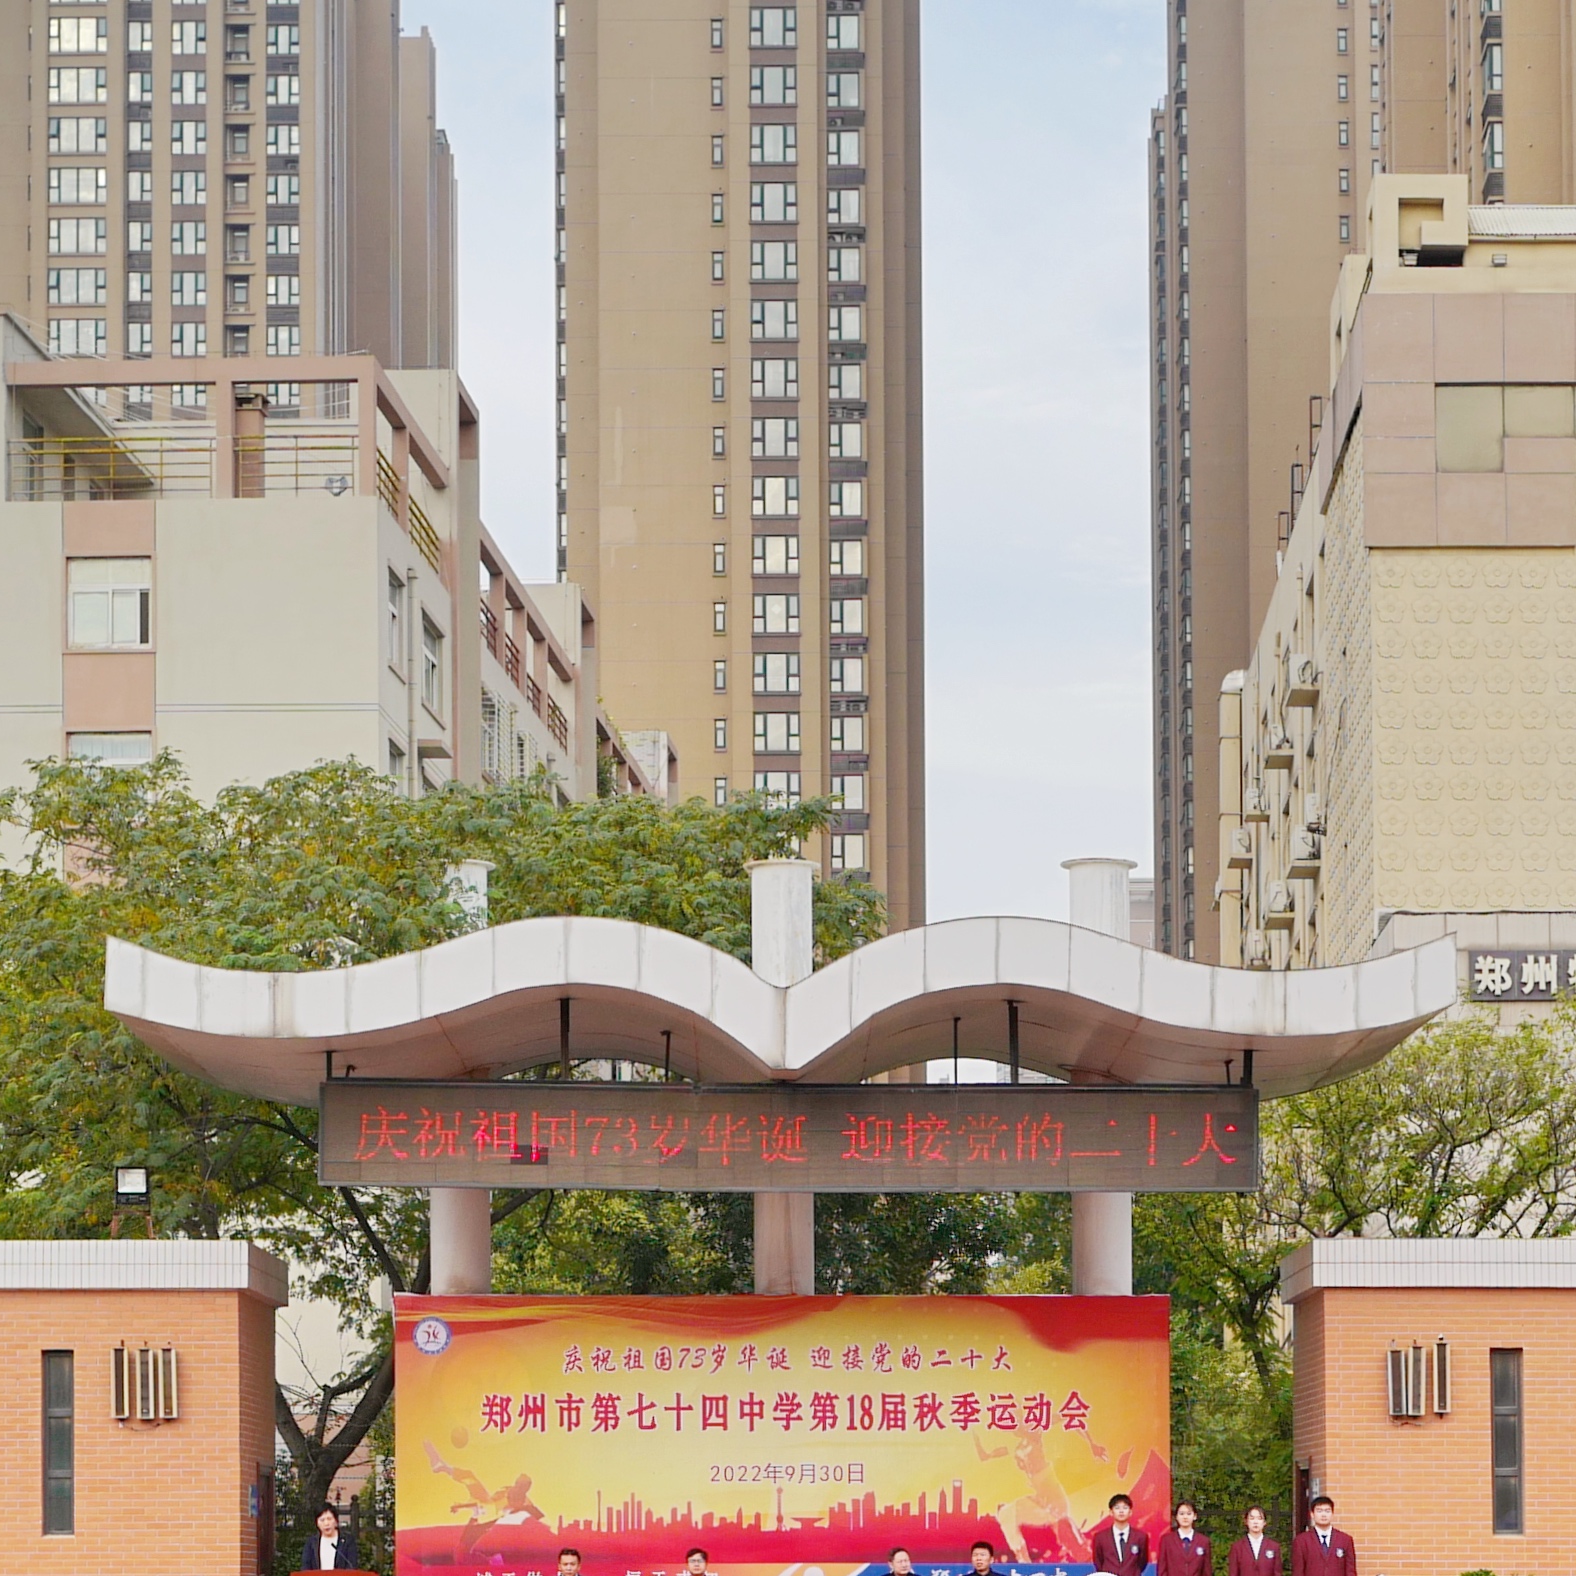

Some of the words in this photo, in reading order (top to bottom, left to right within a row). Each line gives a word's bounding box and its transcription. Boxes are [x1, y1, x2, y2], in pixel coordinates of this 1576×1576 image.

[354, 1105, 809, 1165] 庆祝祖国73岁华诞
[563, 1344, 792, 1375] 庆祝祖国73岁华诞
[810, 1342, 1013, 1373] 迎接党的二十大
[480, 1390, 1091, 1433] 郑州市第七十四中学第18届秋季运动会
[709, 1462, 864, 1485] 2022年9月30日
